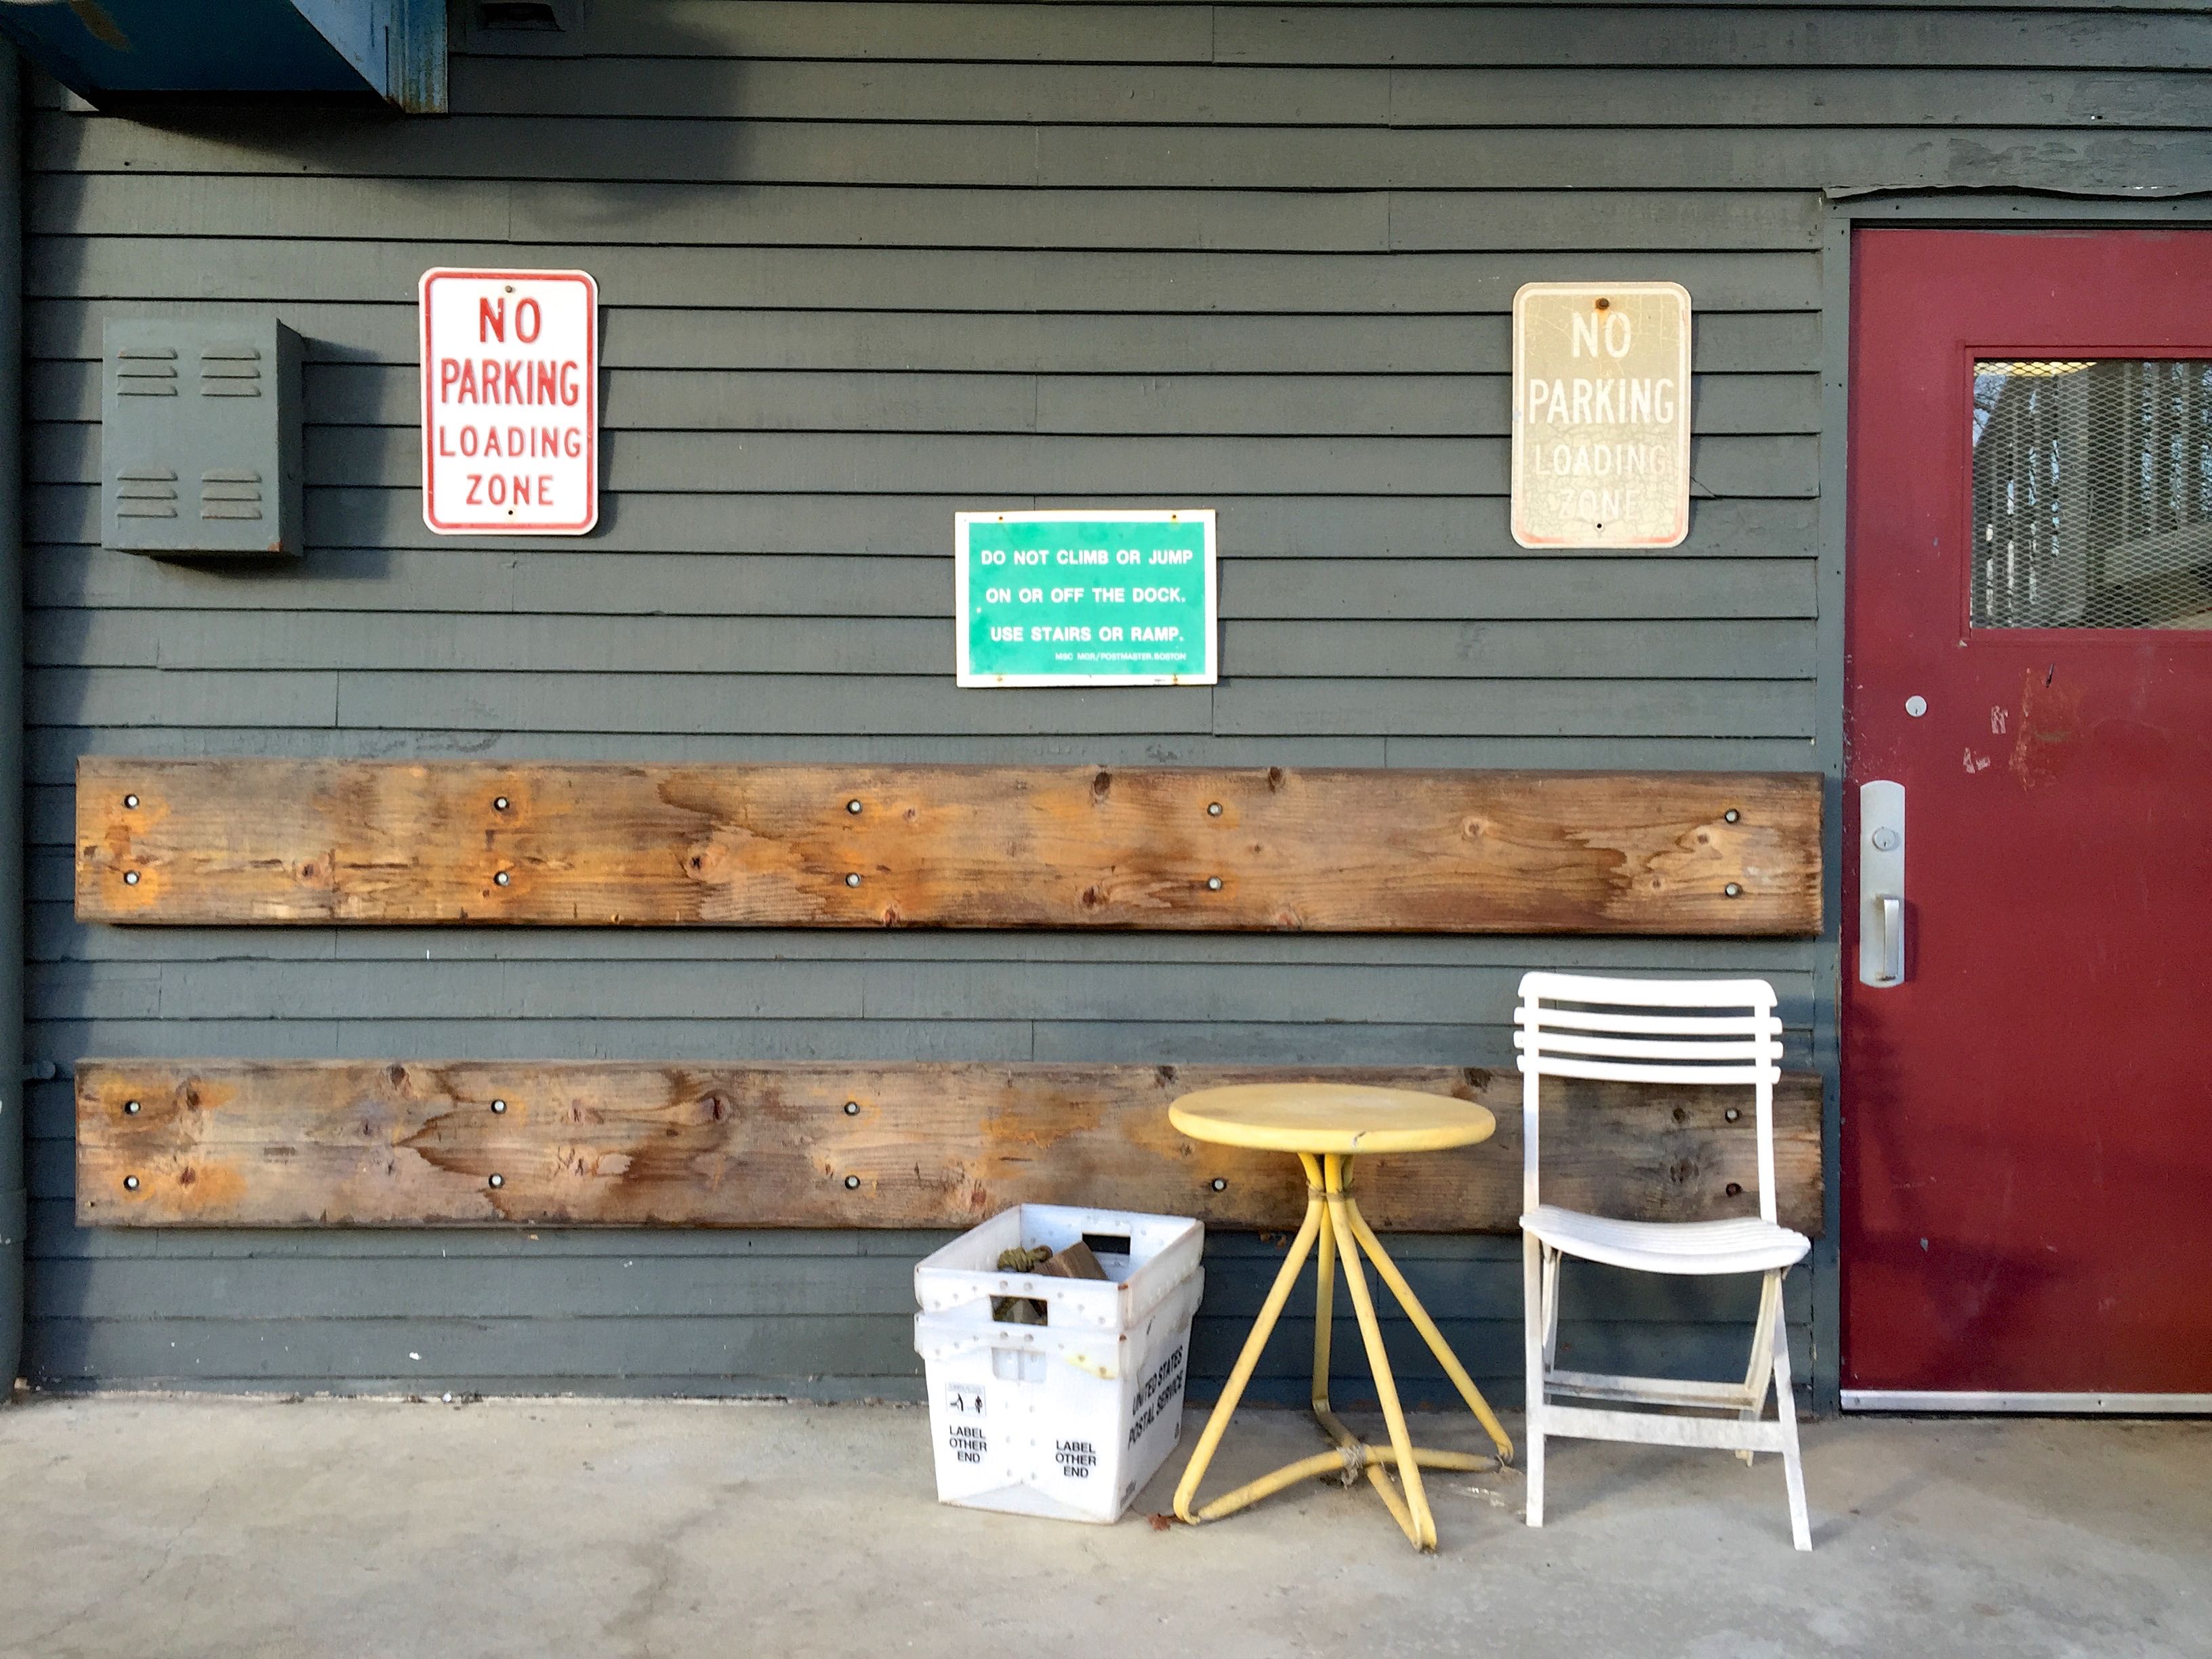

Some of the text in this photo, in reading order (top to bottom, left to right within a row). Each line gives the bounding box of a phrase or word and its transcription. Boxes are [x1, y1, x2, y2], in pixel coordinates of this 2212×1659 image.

[479, 297, 541, 344] NO
[1572, 312, 1631, 359] NO
[441, 359, 579, 406] PARKING
[1528, 377, 1674, 425] PARKING
[439, 425, 581, 458] LOADING
[1535, 444, 1666, 476] LOADING
[466, 474, 554, 506] ZONE
[1559, 488, 1640, 520] ZONE
[981, 550, 1193, 565] DO NOT CLIMB OR JUMP
[986, 588, 1186, 603] ON OR OFF THE DOCK.
[991, 626, 1184, 642] USE STAIRS OR RAMP.
[1054, 652, 1073, 661] MSC
[1132, 1345, 1183, 1416] UNITED STATES
[1128, 1402, 1155, 1451] POSTAL
[1156, 1370, 1183, 1417] SERVICE
[949, 1425, 986, 1439] LABEL
[949, 1437, 987, 1452] OTHER
[1056, 1440, 1096, 1454] LABEL
[957, 1451, 981, 1463] END
[1055, 1453, 1097, 1467] OTHER
[1063, 1466, 1088, 1478] END
